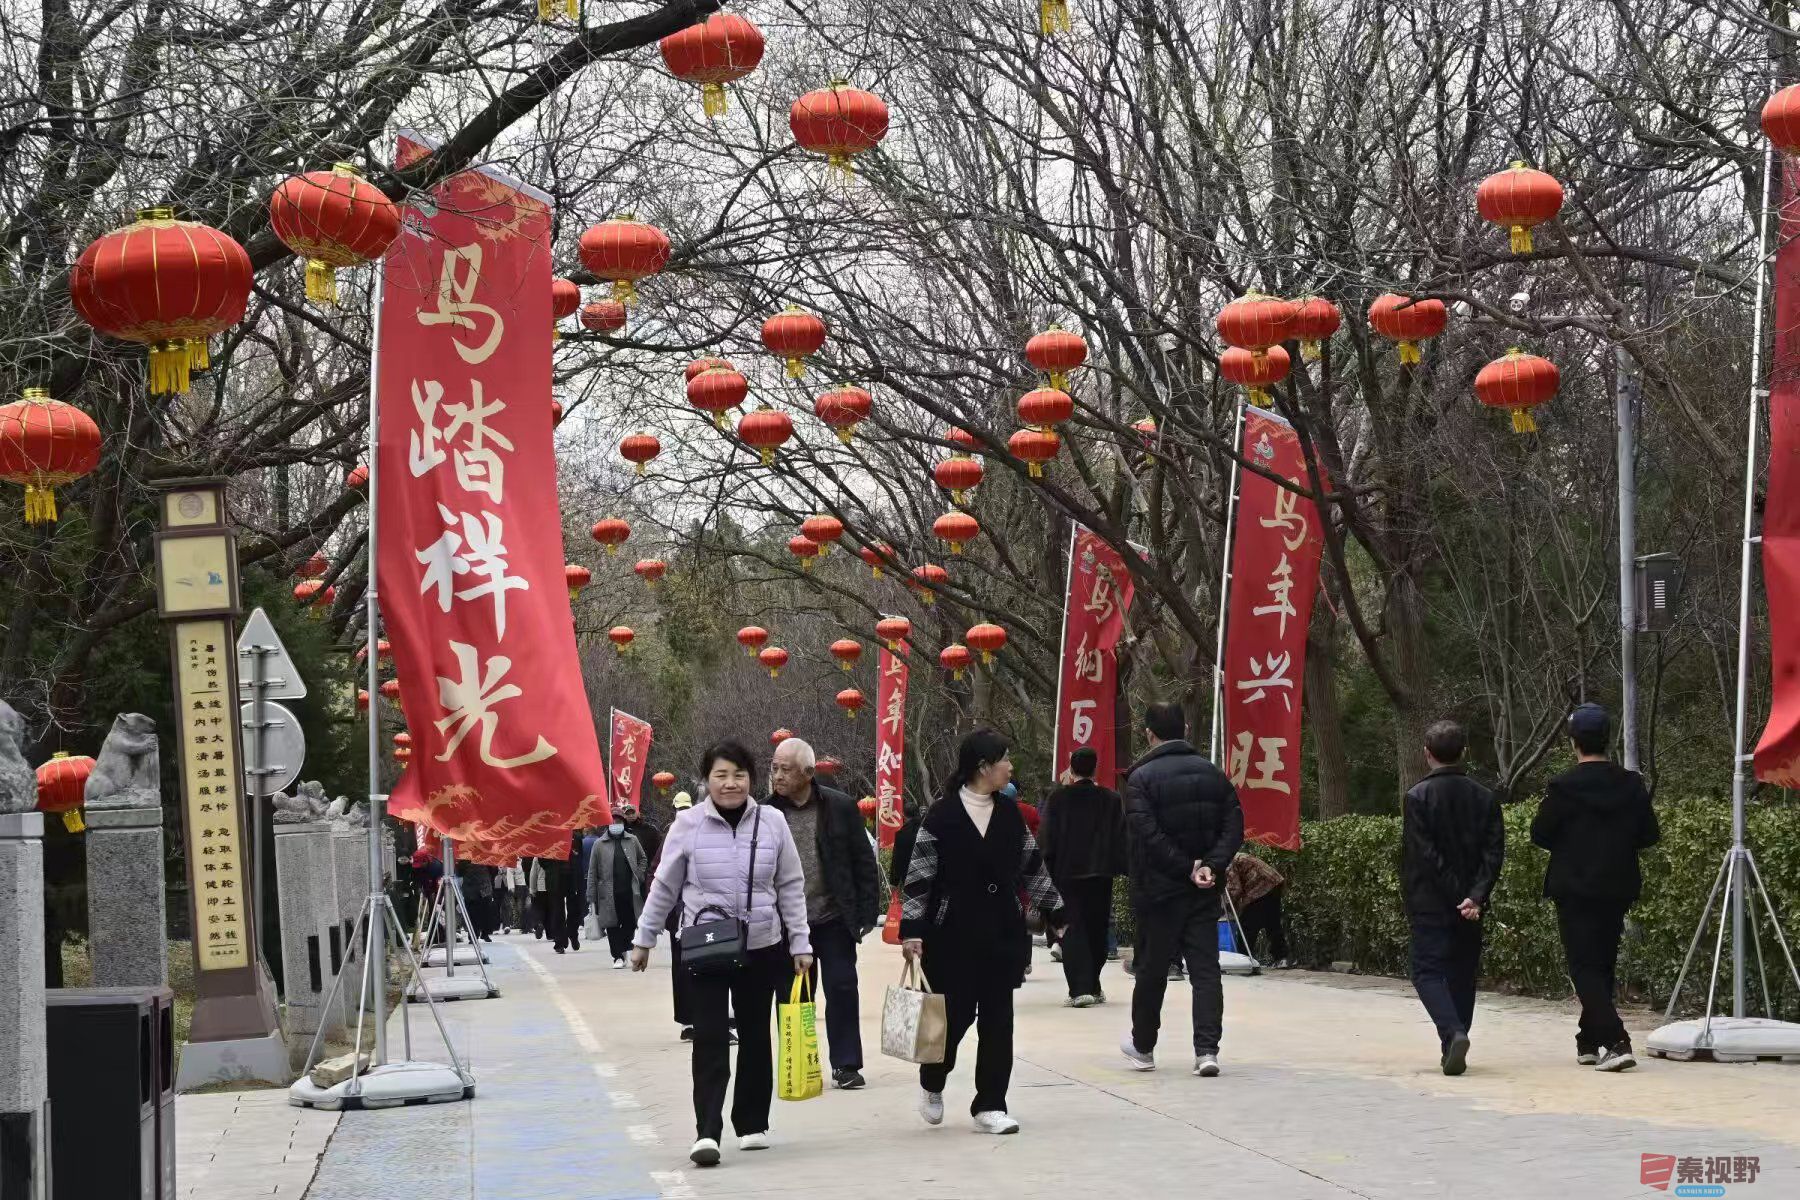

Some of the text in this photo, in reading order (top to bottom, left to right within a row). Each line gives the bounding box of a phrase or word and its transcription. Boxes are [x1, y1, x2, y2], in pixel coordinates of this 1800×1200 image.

[409, 242, 557, 767] 马踏祥光
[1230, 476, 1308, 794] 马年兴旺
[617, 734, 637, 806] 龙马
[1060, 572, 1113, 785] 马纳百
